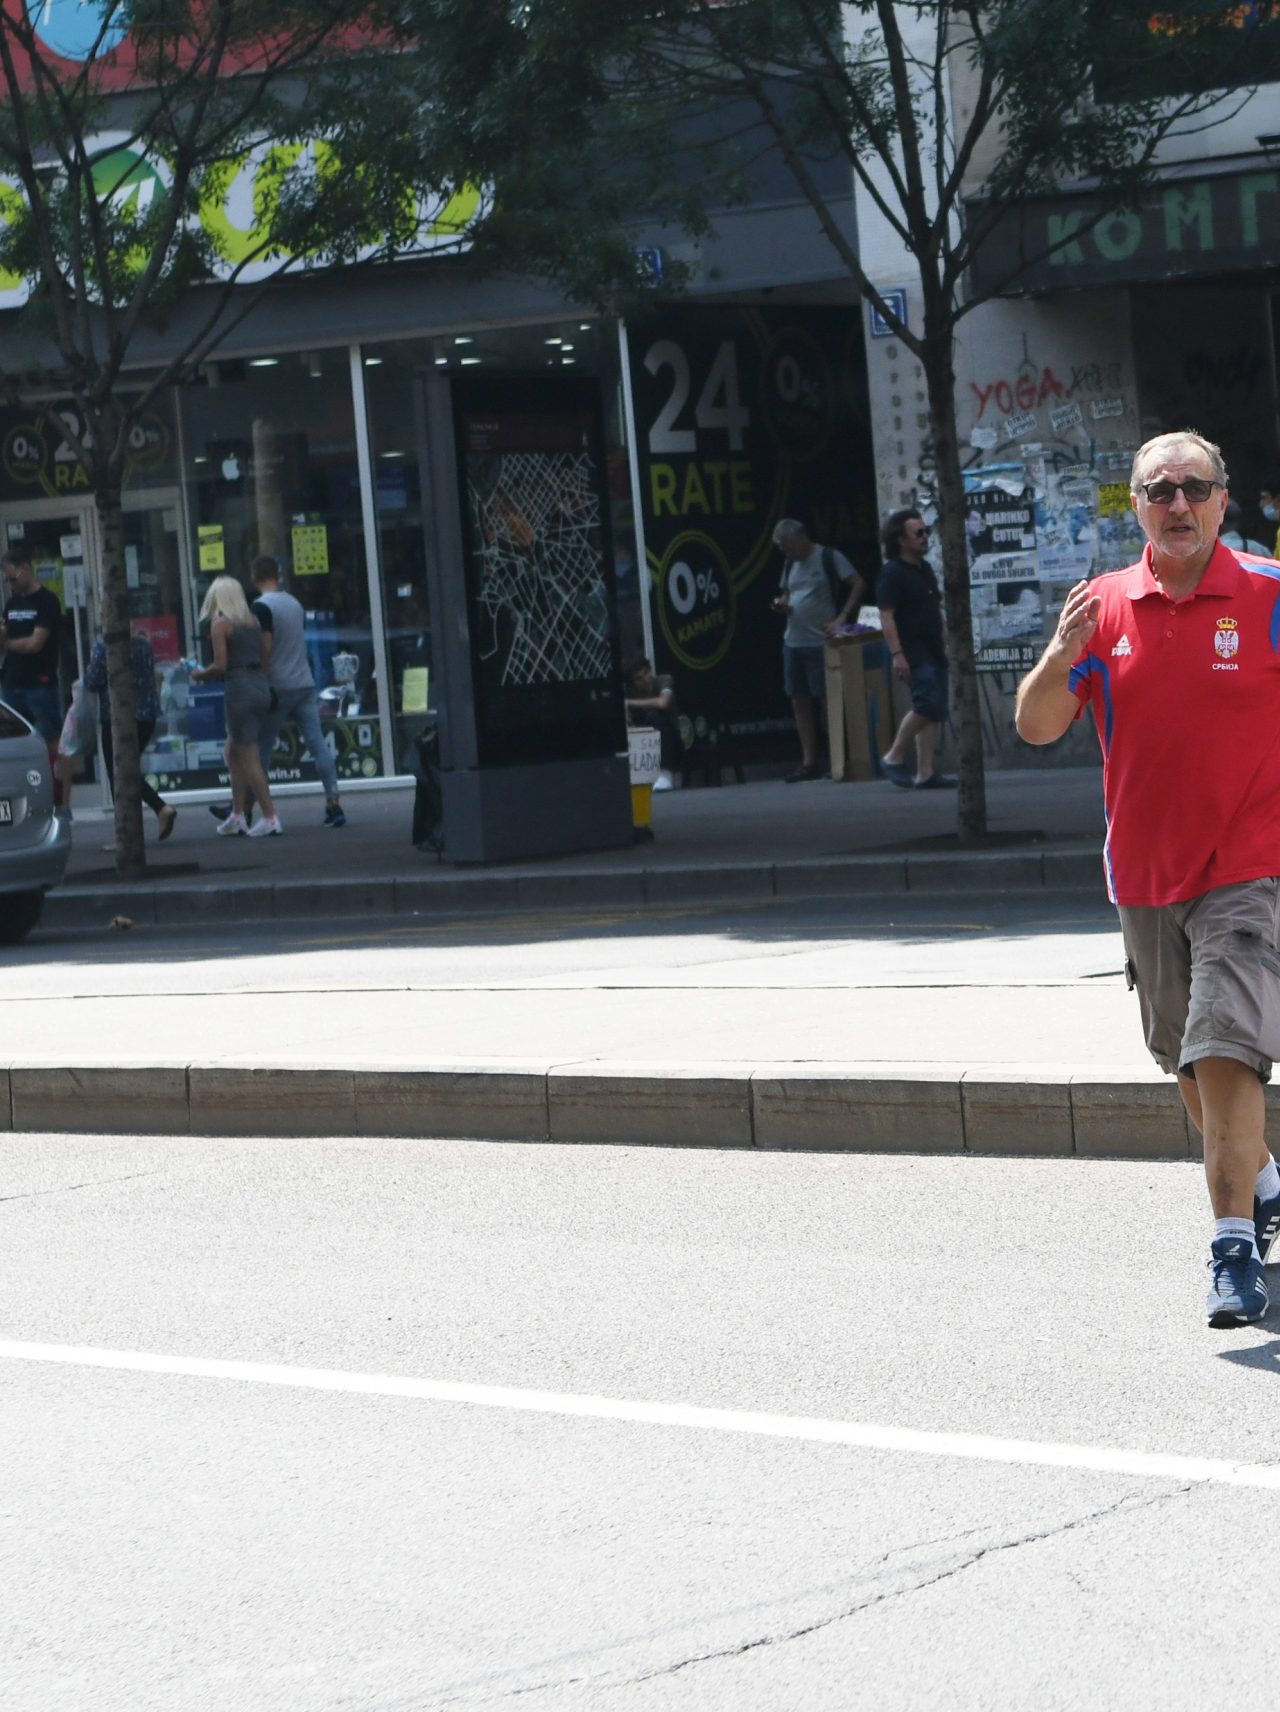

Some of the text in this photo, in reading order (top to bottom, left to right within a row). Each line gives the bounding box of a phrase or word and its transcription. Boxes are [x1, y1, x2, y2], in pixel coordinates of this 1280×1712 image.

[643, 338, 751, 453] 24
[650, 460, 756, 517] RATE
[668, 561, 719, 615] 0%
[1212, 663, 1239, 671] СРБИЈА
